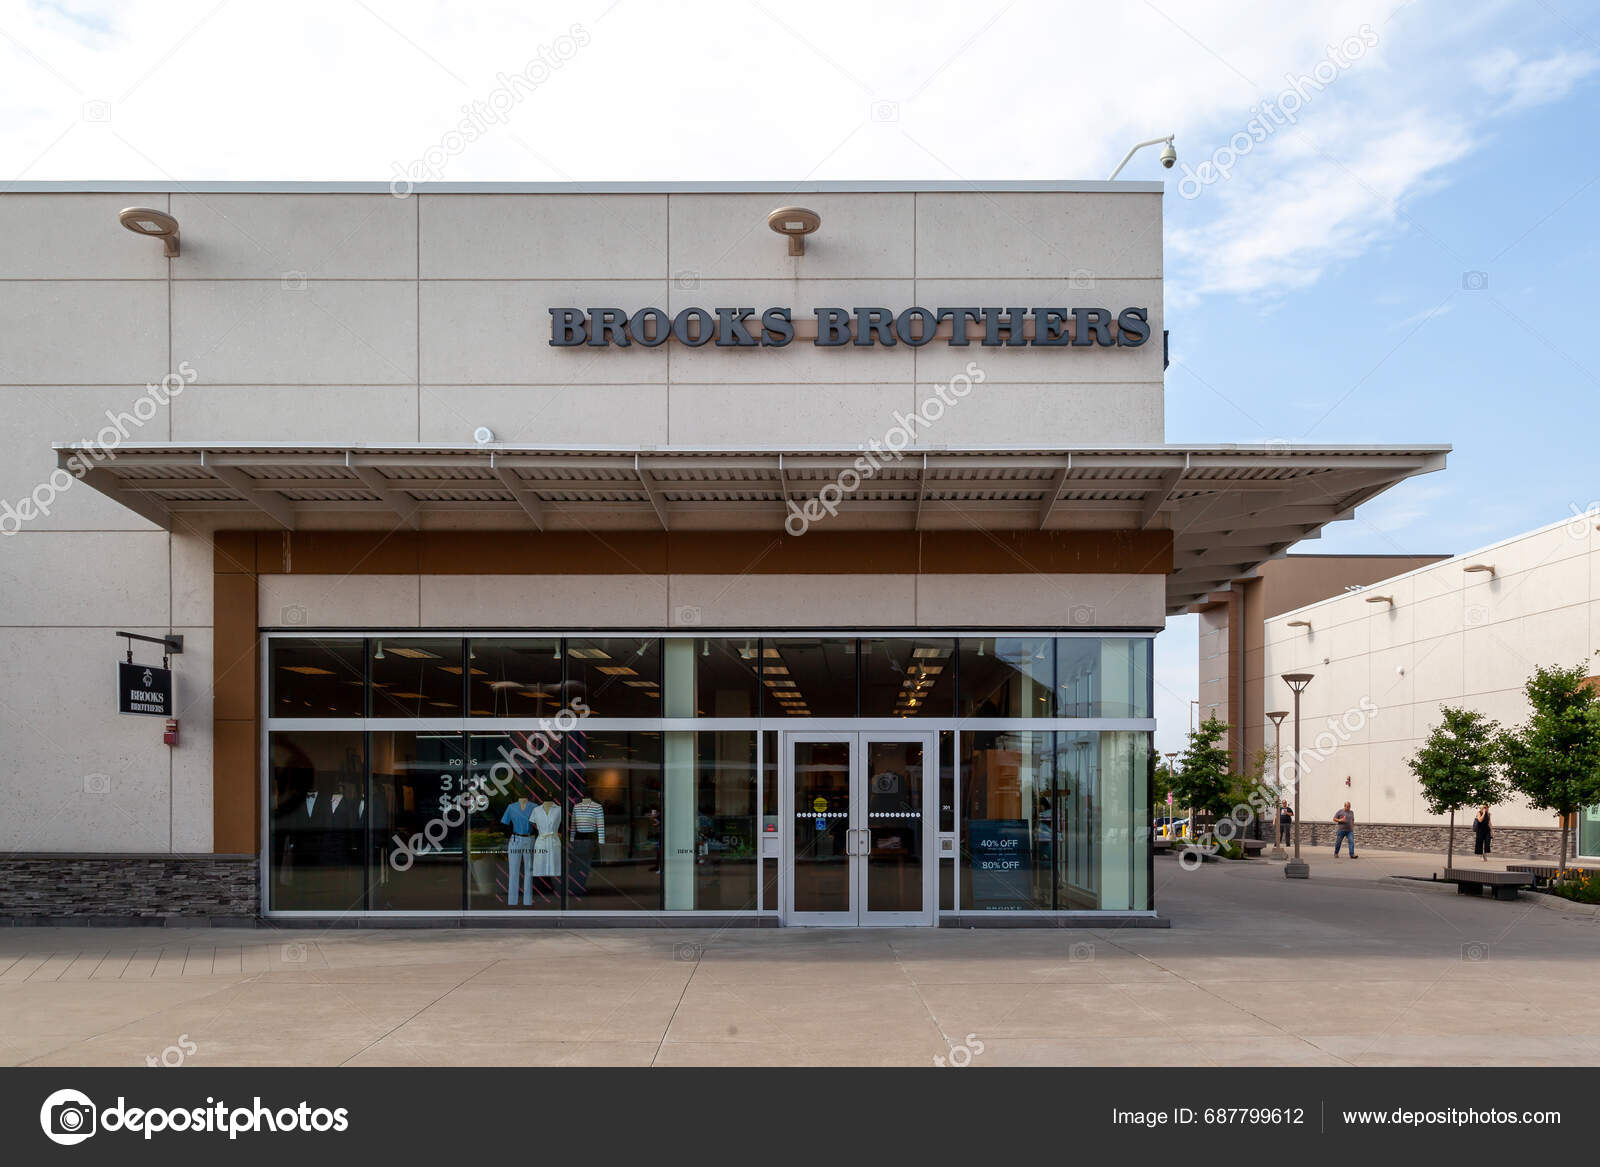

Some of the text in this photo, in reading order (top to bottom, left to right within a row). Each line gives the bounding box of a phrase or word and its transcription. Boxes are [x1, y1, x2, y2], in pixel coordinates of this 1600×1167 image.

[548, 307, 1151, 348] BROOKS BROTHERS
[130, 690, 164, 703] BROOKS
[130, 702, 164, 713] BROTHERS
[440, 774, 453, 791] 3
[981, 839, 1018, 848] 40% OFF
[982, 861, 1020, 869] 80% OFF
